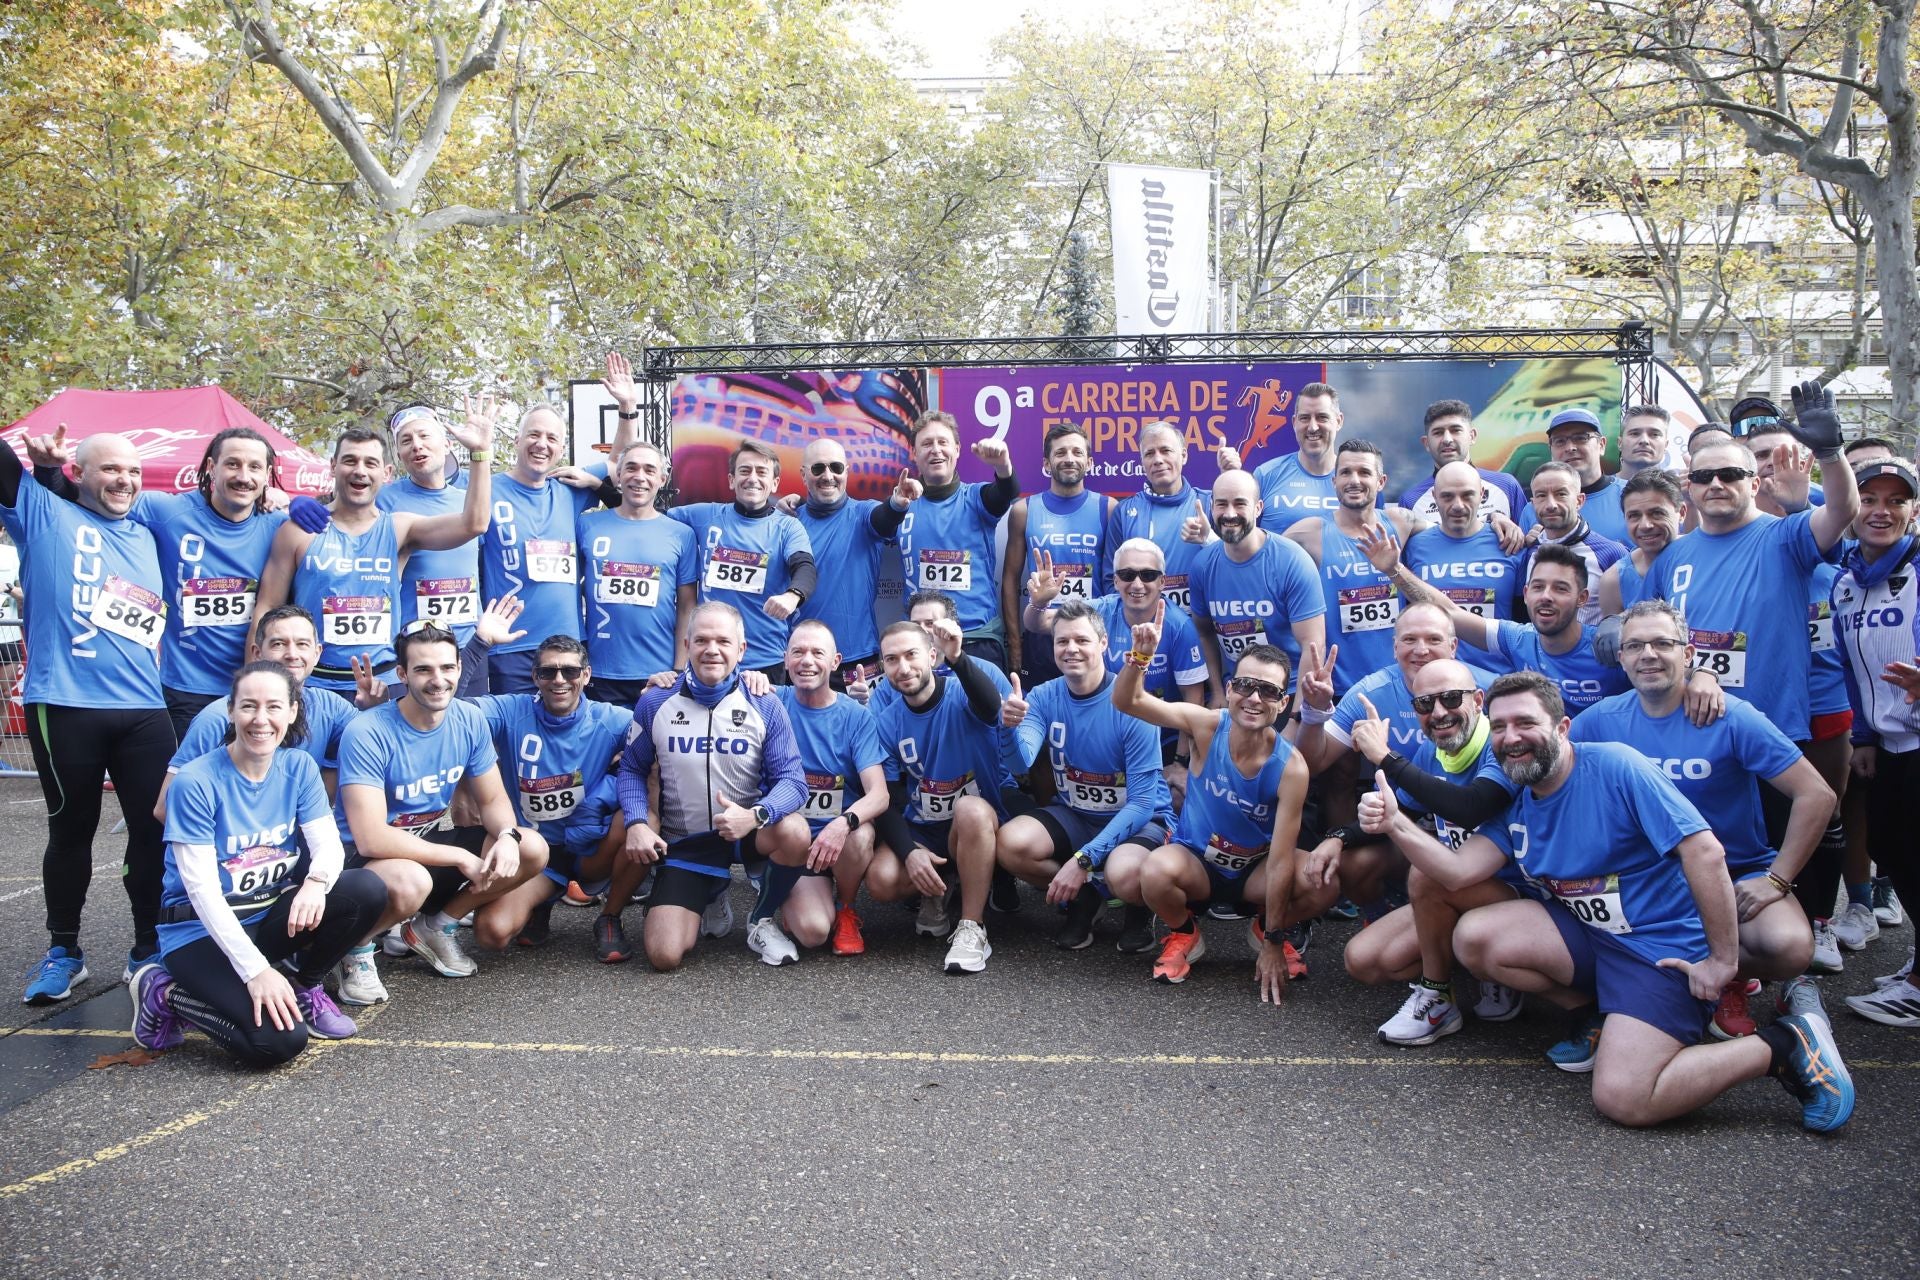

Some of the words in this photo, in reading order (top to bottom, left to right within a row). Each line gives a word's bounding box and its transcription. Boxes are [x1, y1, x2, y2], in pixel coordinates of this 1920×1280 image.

[1041, 381, 1180, 413] CARRERA
[1190, 380, 1228, 411] DE
[1042, 416, 1227, 453] PRAS
[1104, 461, 1118, 476] de
[1273, 495, 1340, 509] IVEC
[1030, 533, 1098, 548] IVECO
[495, 501, 524, 607] VECO
[900, 512, 918, 596] VECO
[1071, 547, 1097, 556] running
[306, 556, 391, 572] IVECO
[535, 557, 571, 574] 573
[1327, 562, 1381, 578] IVE
[1422, 562, 1505, 580] IVECO
[361, 574, 391, 583] running
[717, 565, 757, 584] 587
[926, 565, 963, 582] 612
[71, 525, 101, 658] IVECO
[609, 580, 650, 597] 580
[1061, 580, 1084, 595] 64
[194, 596, 246, 617] 585
[428, 596, 470, 616] 572
[1209, 600, 1274, 617] IVECO
[1349, 602, 1391, 622] 563
[106, 598, 156, 635] 584
[334, 616, 382, 635] 567
[1691, 652, 1730, 674] 78
[669, 737, 748, 755] IVECO
[529, 791, 575, 812] 588
[805, 792, 832, 809] 70
[1076, 784, 1117, 804] 593
[1215, 852, 1247, 869] 56
[240, 862, 287, 891] 610
